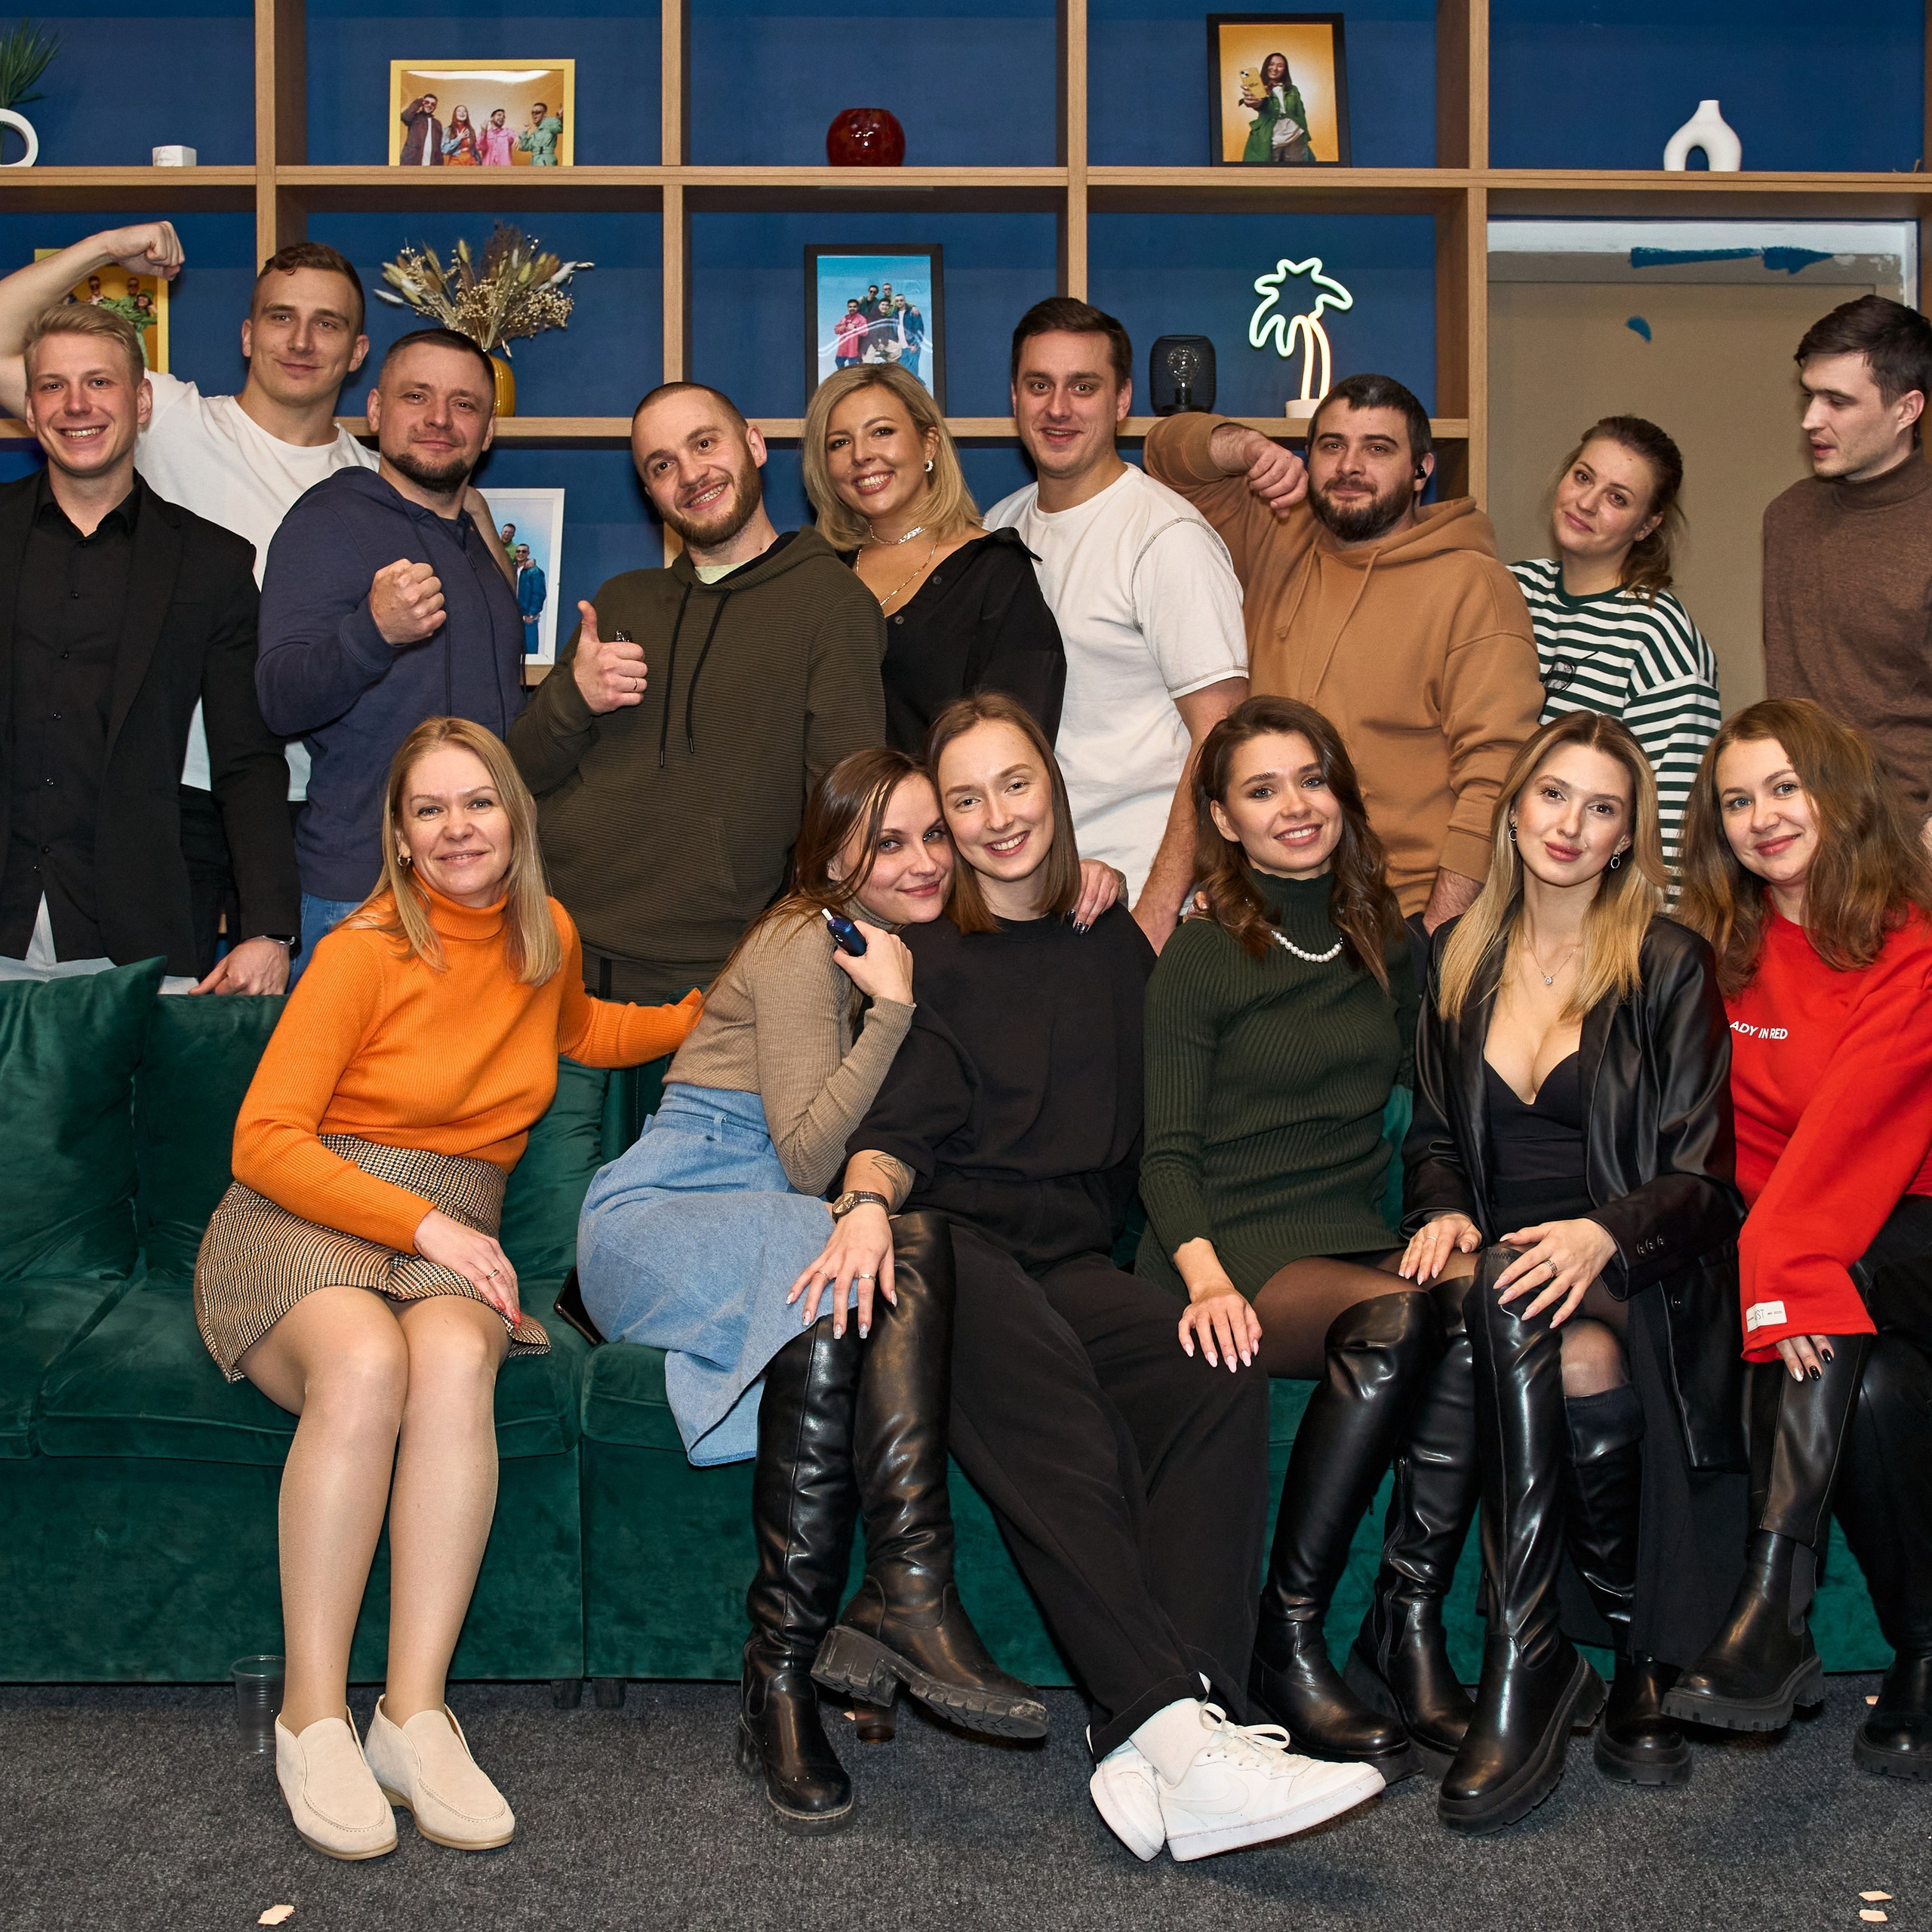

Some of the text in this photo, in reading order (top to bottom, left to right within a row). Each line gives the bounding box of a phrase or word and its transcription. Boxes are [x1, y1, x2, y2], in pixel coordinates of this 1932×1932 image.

[1728, 1020, 1789, 1040] ADY IN RED
